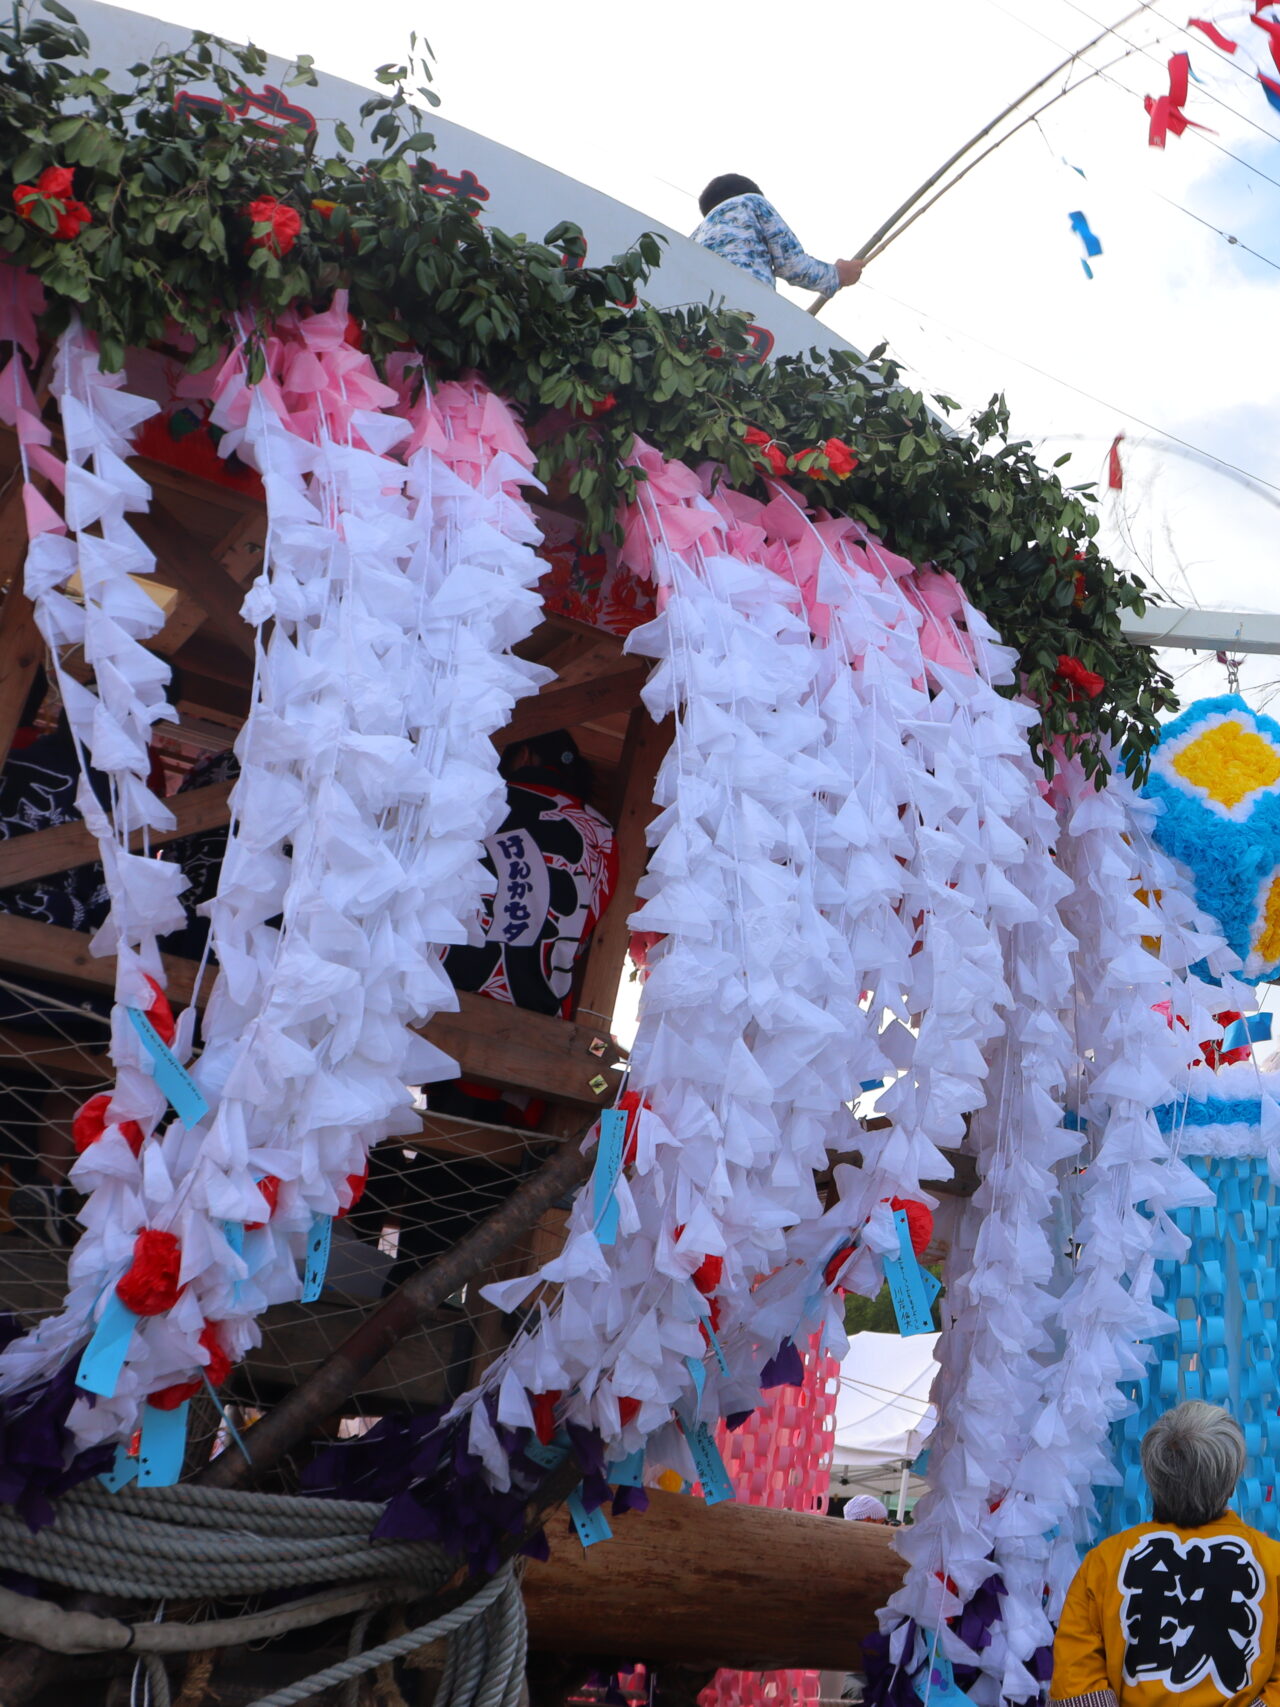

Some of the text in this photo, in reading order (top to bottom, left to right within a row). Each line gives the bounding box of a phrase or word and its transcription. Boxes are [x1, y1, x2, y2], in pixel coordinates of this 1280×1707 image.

[496, 834, 534, 943] けんか七夕
[1119, 1532, 1263, 1697] 鉄
